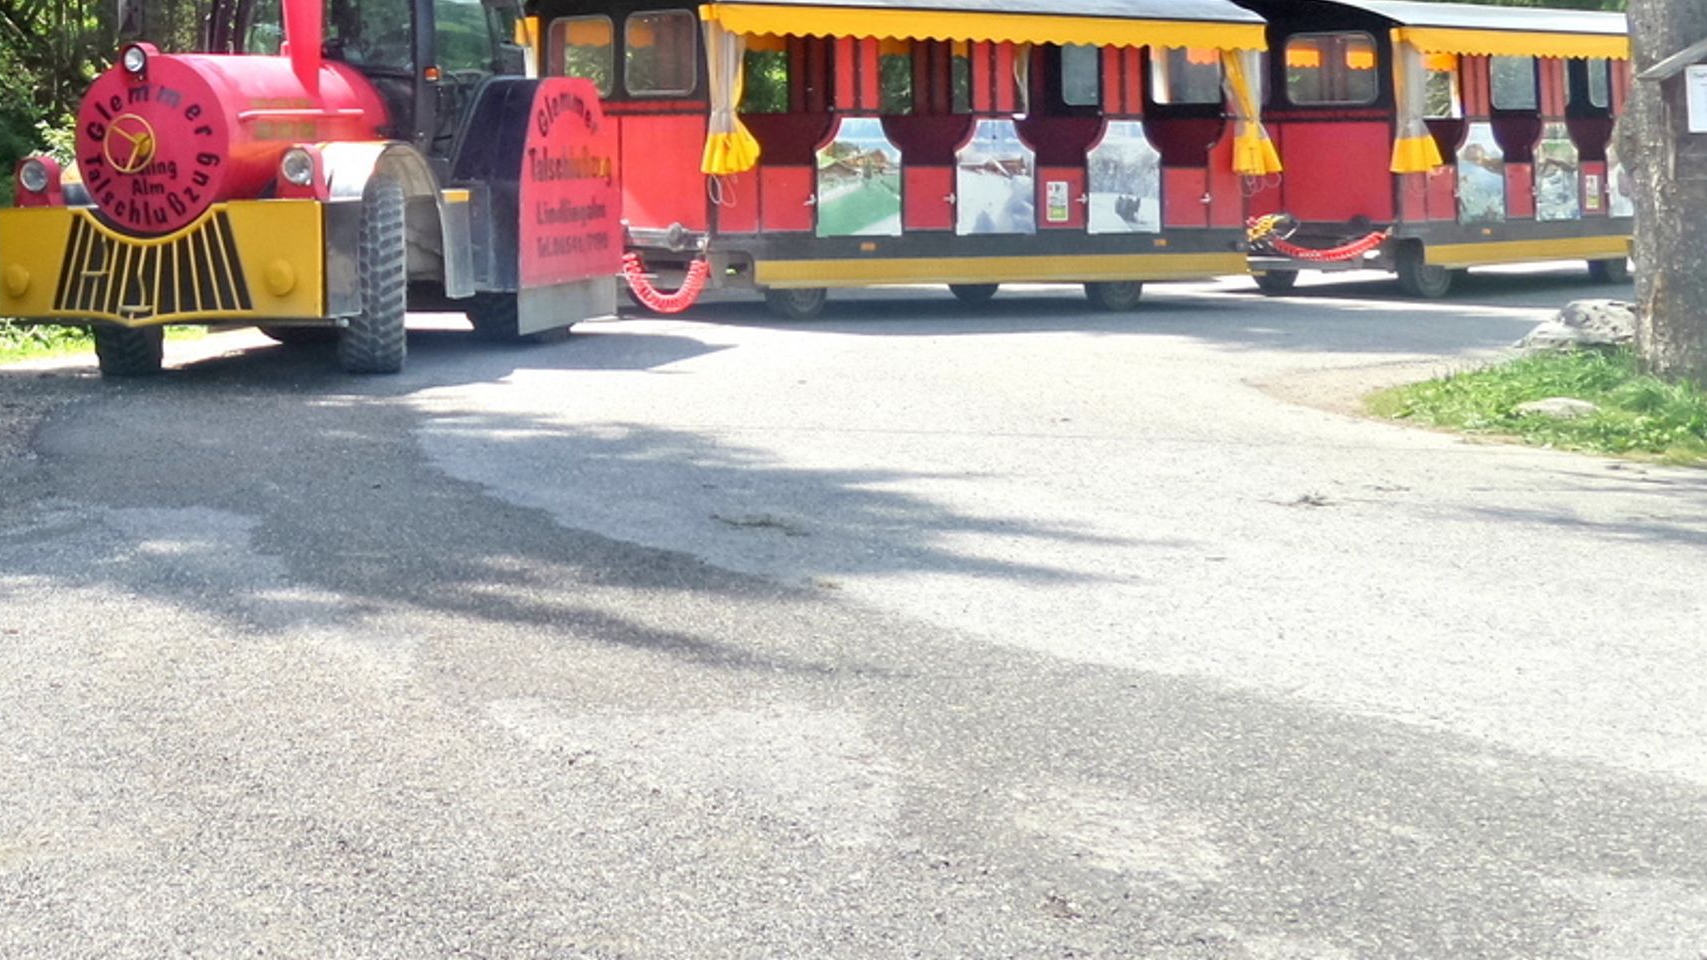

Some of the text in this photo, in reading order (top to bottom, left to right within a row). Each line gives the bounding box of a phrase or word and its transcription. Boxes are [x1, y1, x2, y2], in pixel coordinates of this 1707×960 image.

[86, 84, 213, 142] Glemmer
[85, 152, 221, 226] Talschlußzug
[131, 178, 165, 196] Alm
